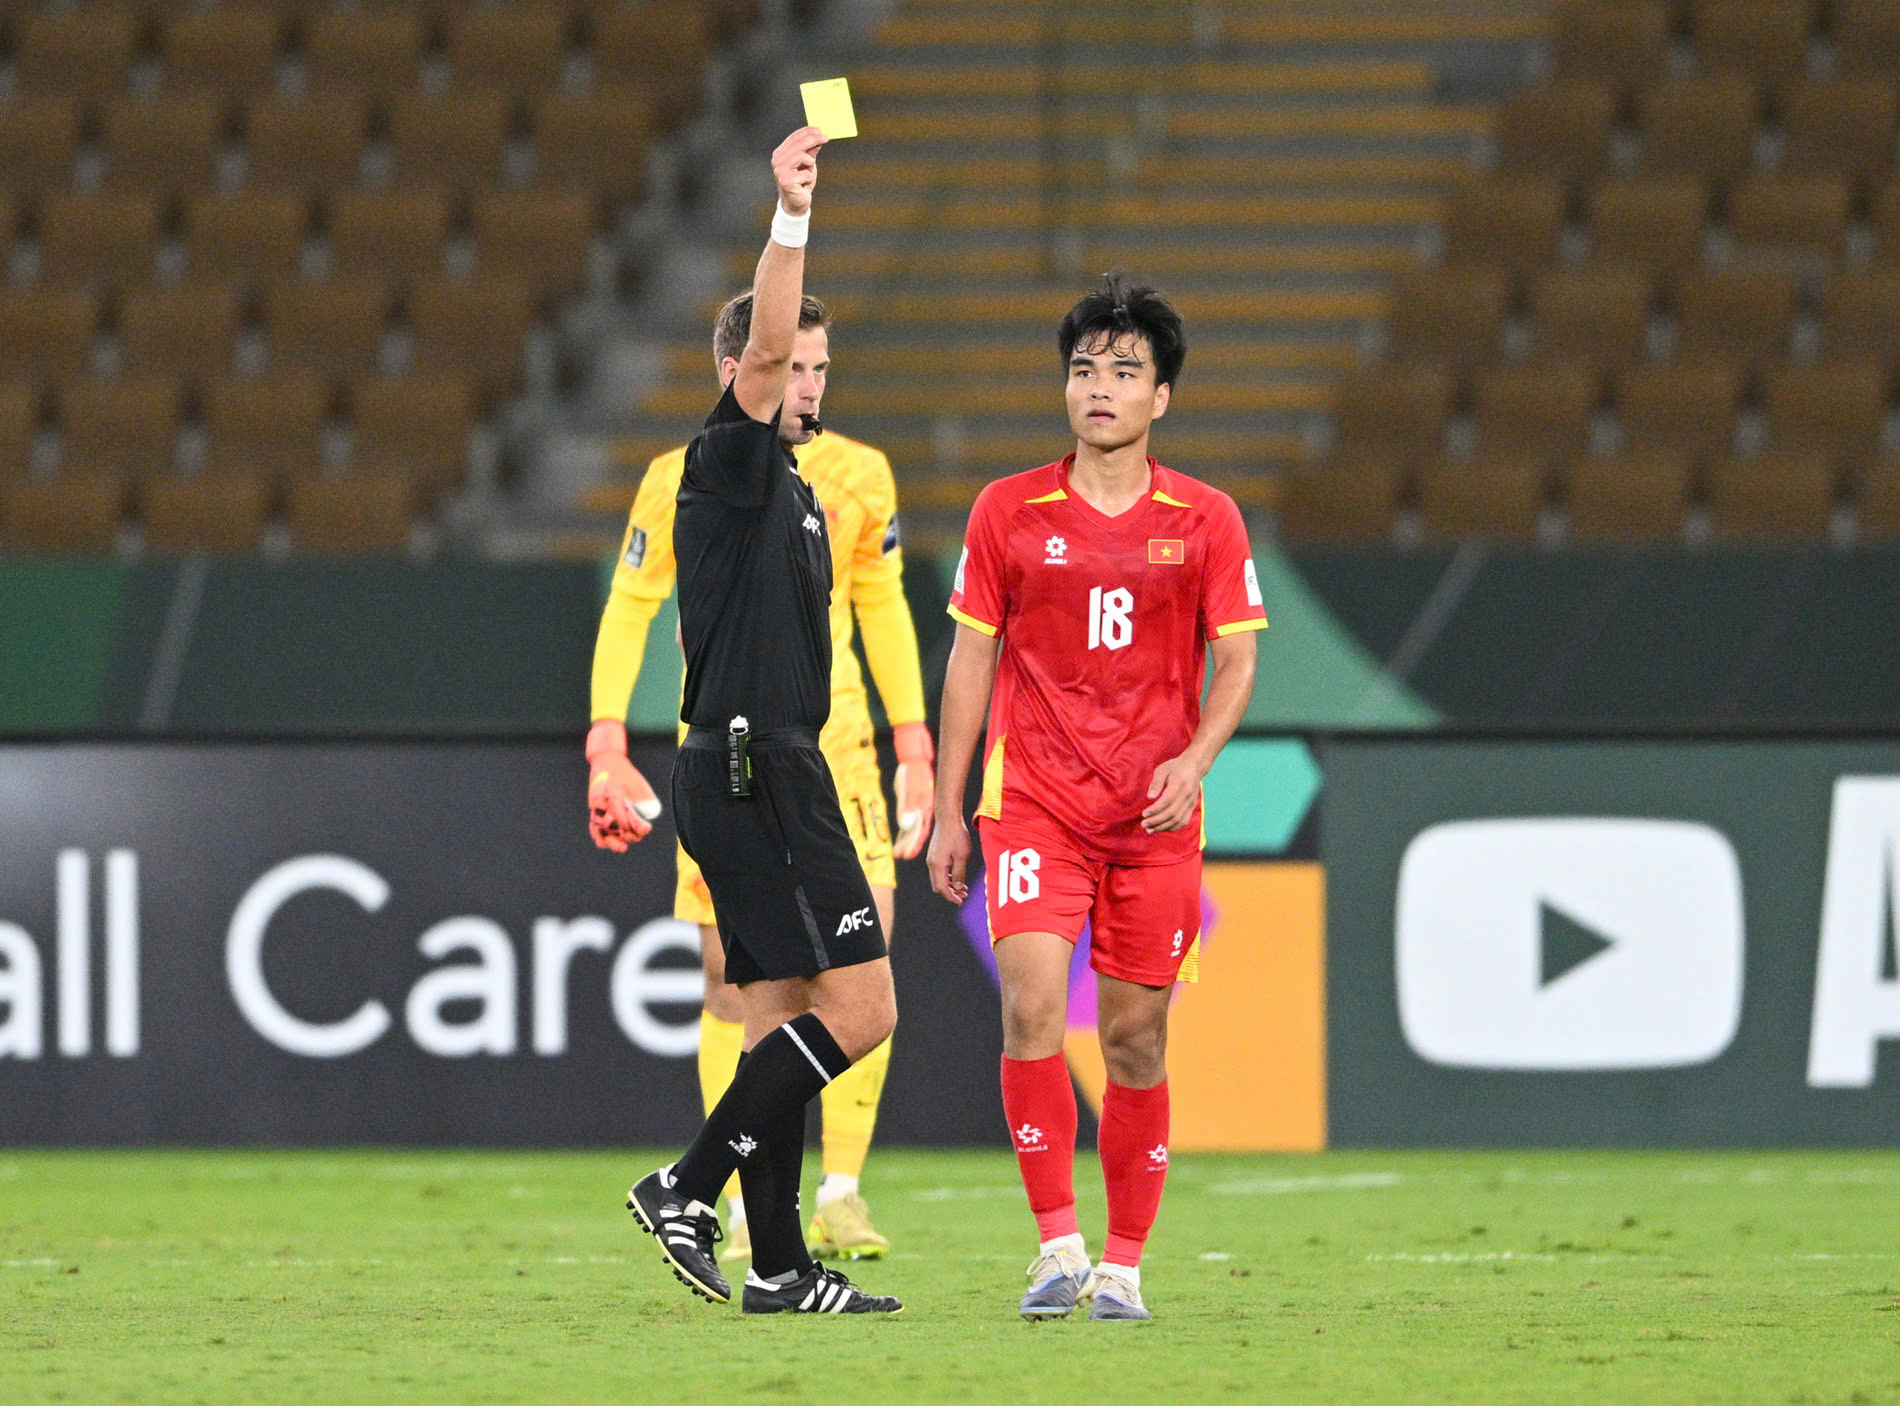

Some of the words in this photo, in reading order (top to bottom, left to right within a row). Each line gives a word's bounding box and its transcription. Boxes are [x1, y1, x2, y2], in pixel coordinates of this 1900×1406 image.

[1088, 586, 1134, 651] 18
[998, 848, 1041, 909] 18
[836, 906, 873, 937] AFC
[225, 853, 706, 1058] Care
